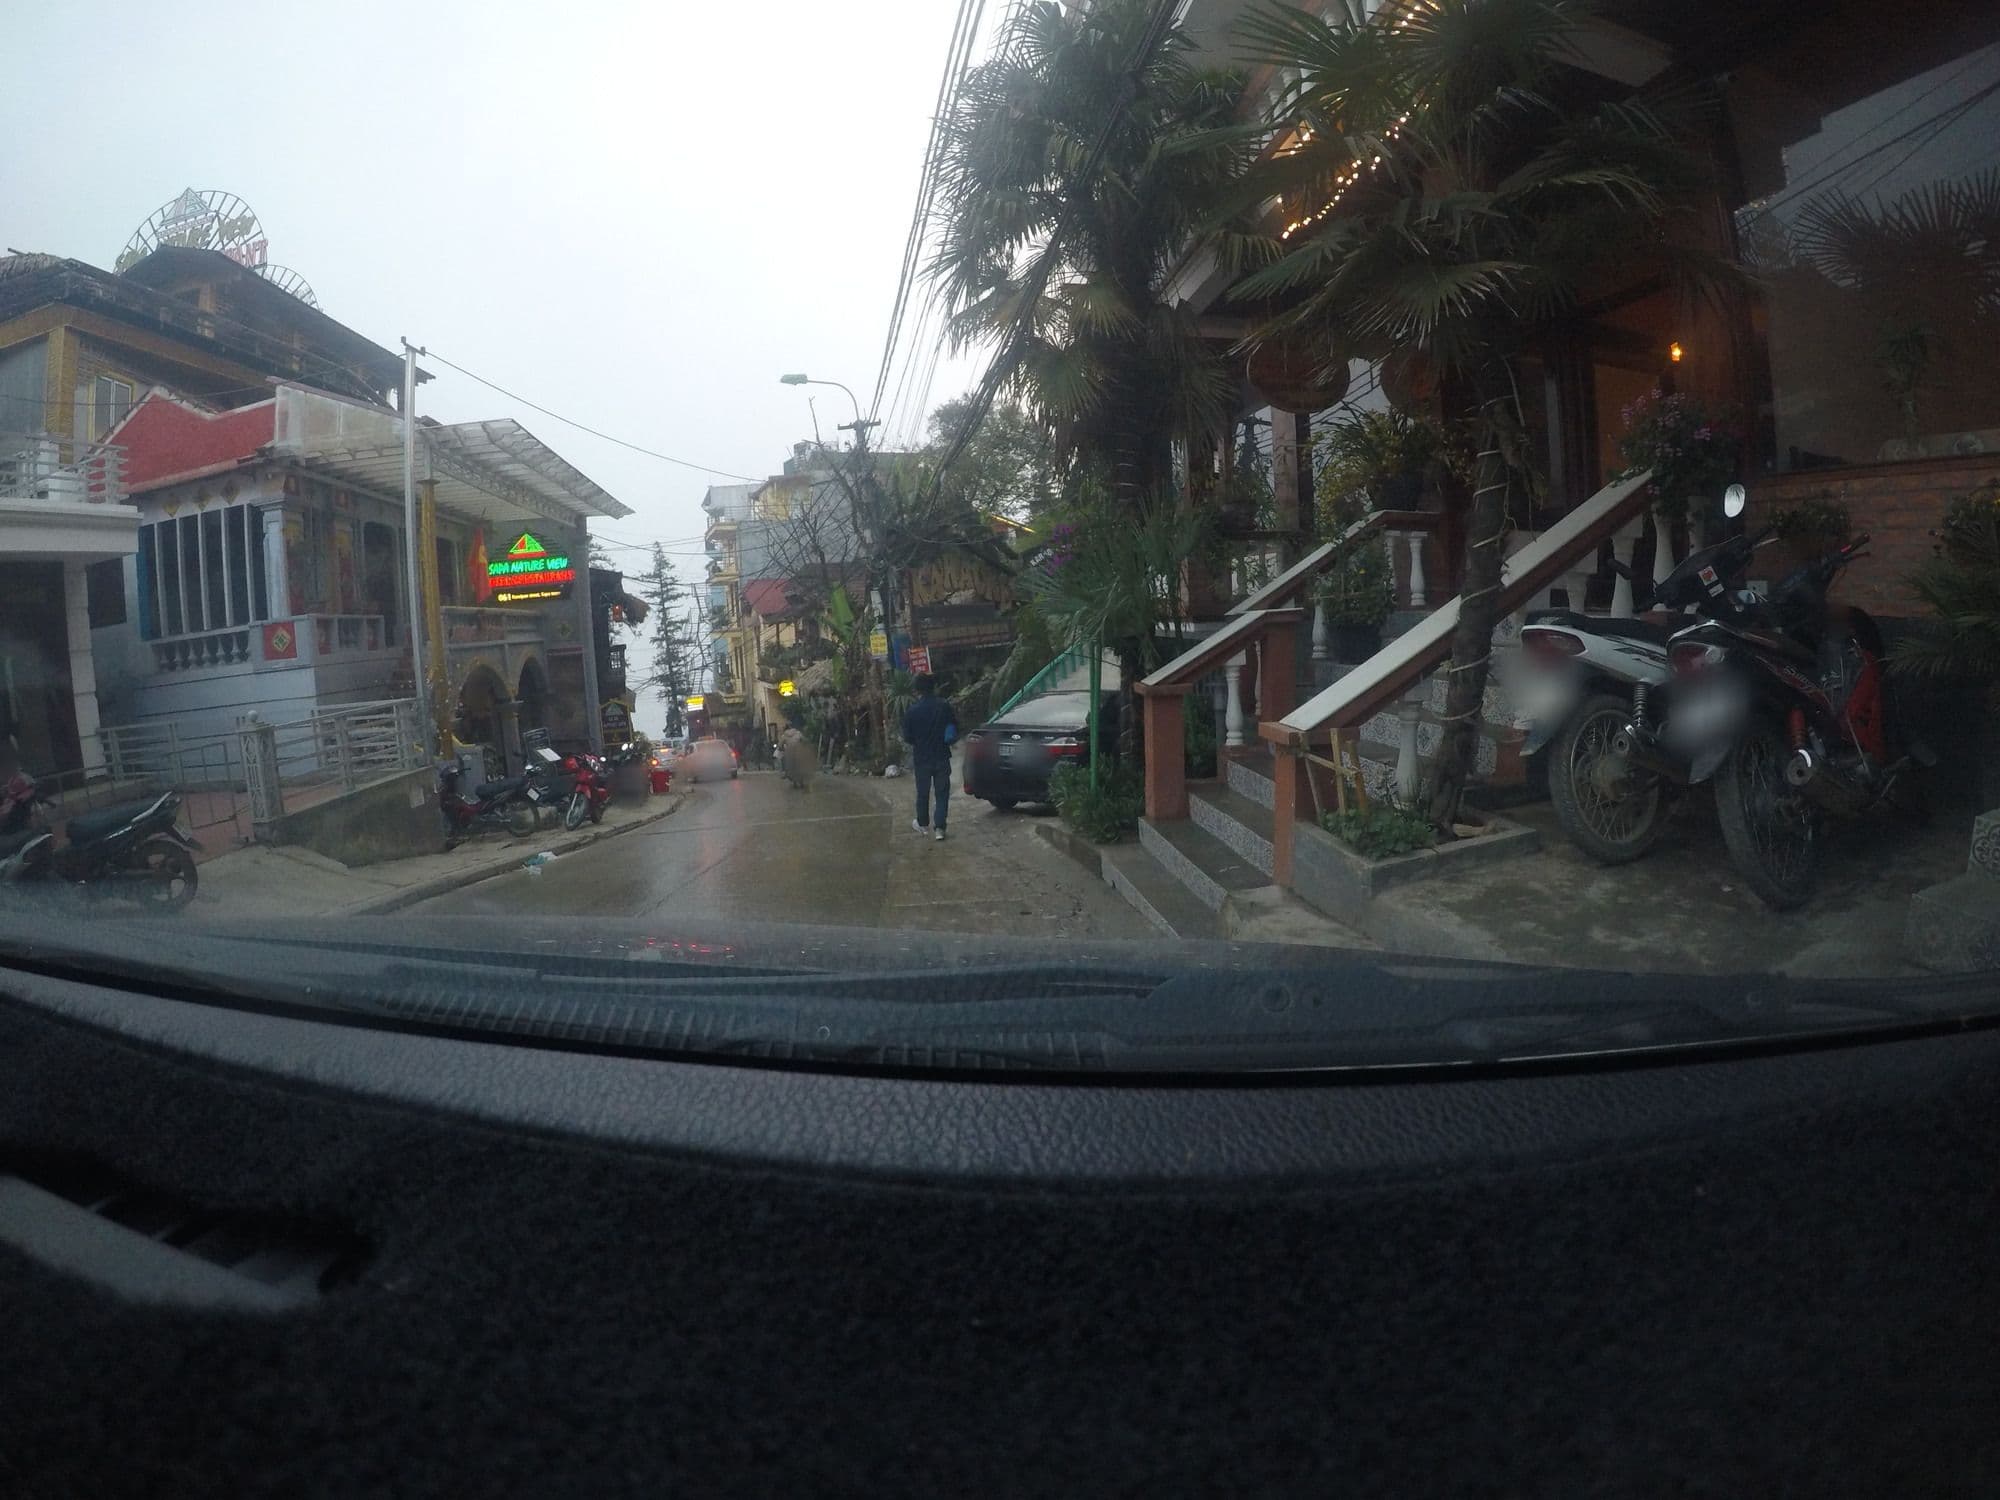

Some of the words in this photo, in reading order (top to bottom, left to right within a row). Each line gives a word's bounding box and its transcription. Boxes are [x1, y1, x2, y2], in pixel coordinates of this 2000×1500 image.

[489, 562, 509, 575] SAPA
[511, 558, 545, 572] NATURE
[547, 557, 568, 569] VIEW
